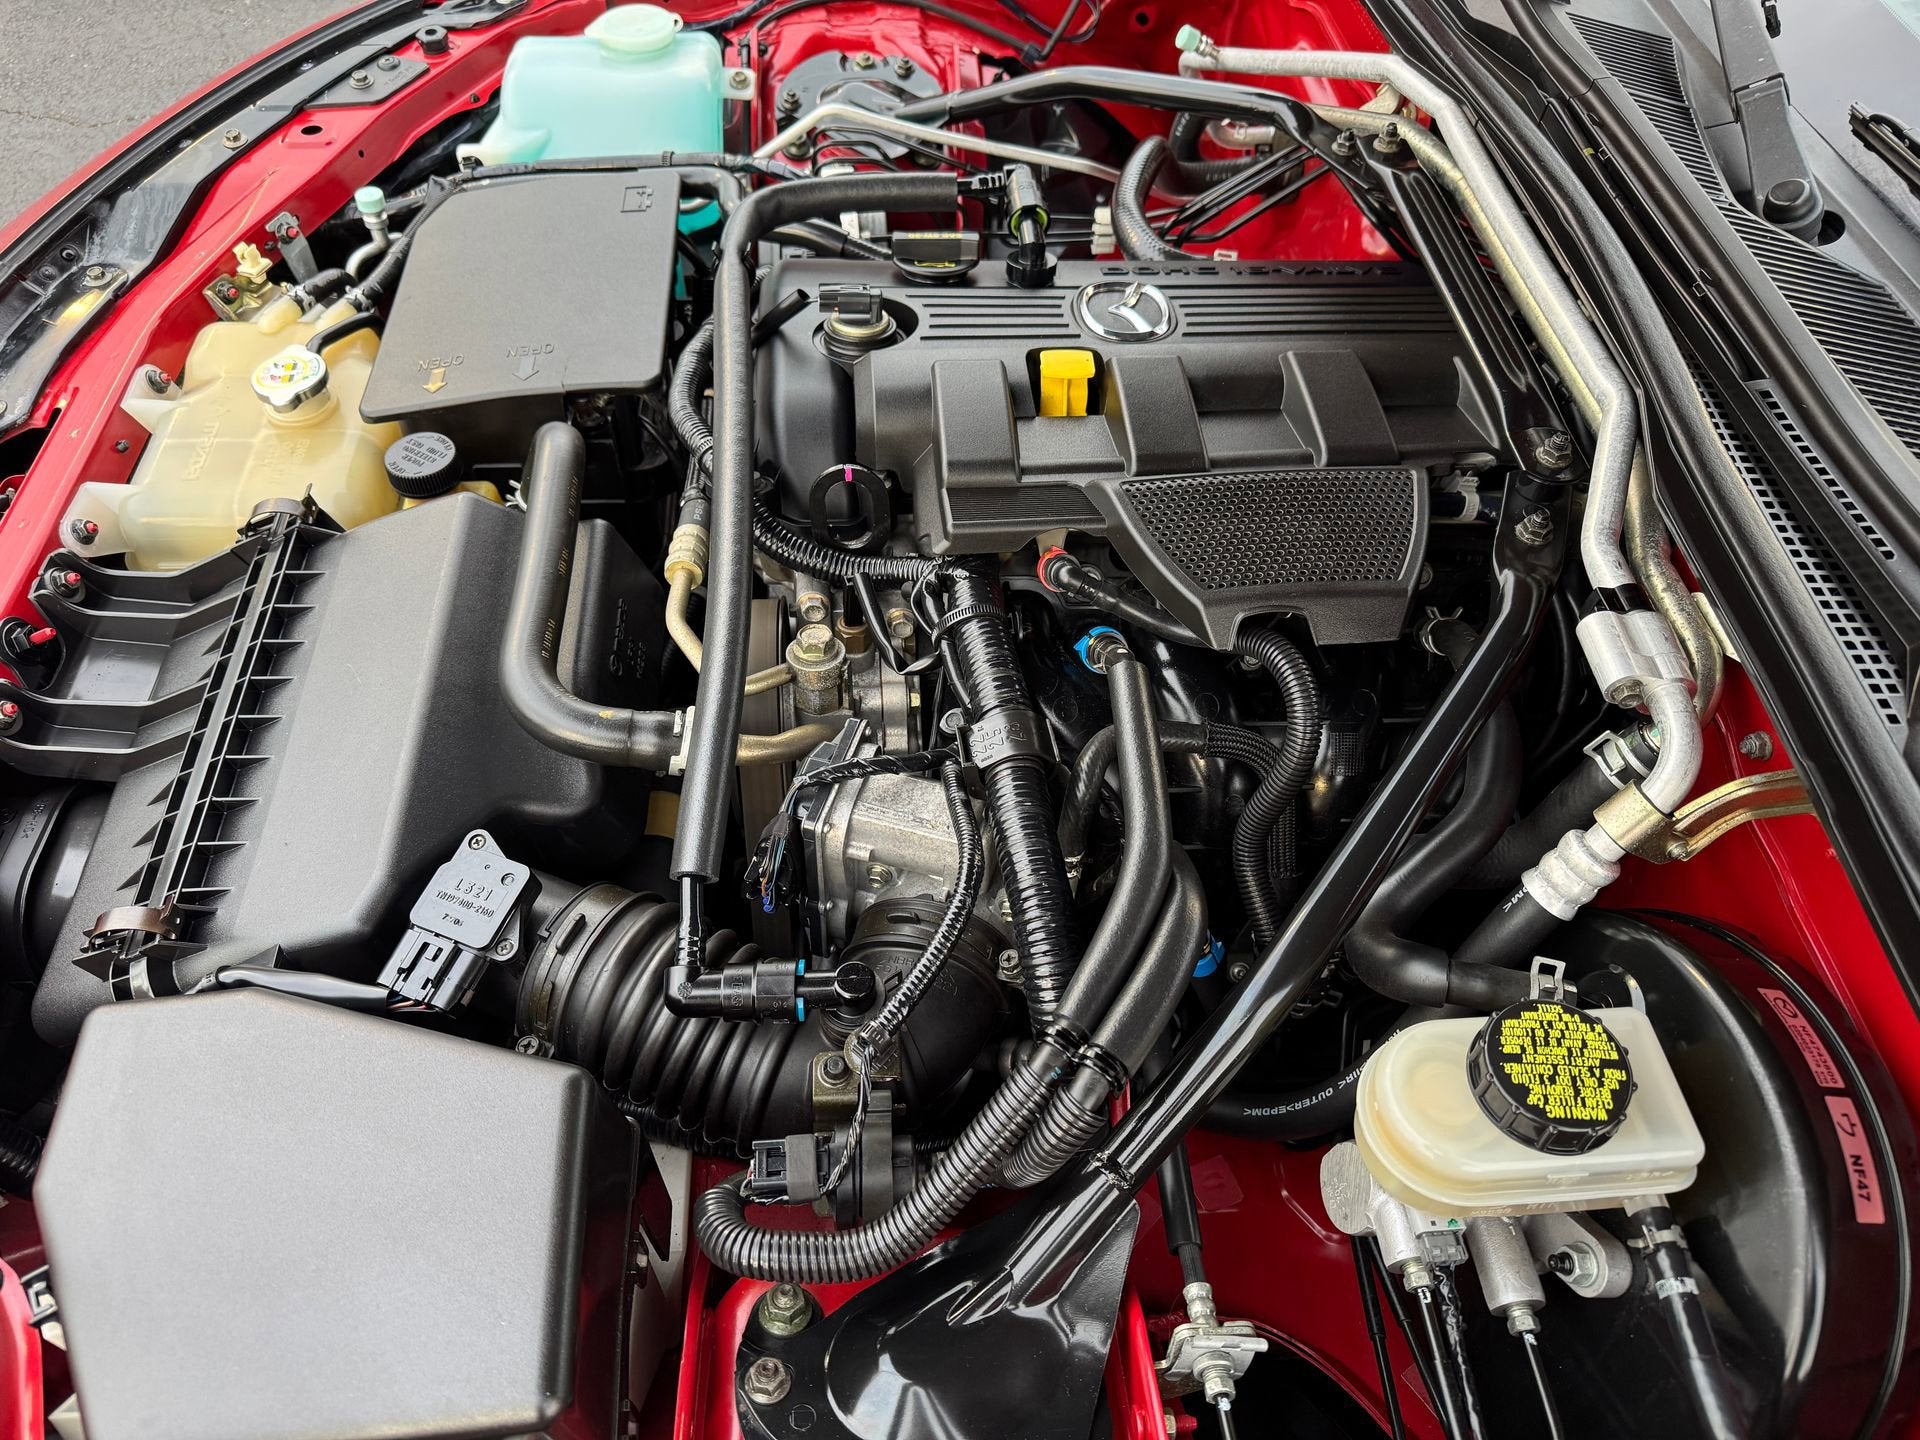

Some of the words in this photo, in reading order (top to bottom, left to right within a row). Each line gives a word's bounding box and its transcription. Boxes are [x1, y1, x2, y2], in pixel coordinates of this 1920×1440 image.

[1100, 266, 1219, 276] DOHC
[506, 343, 554, 358] OPEN
[418, 354, 464, 372] OPEN
[1520, 1011, 1559, 1019] CONTENANT
[1501, 1027, 1532, 1035] LIQUIDE
[1535, 1028, 1544, 1036] DU
[1593, 1024, 1603, 1032] DE
[1535, 1037, 1544, 1045] LE
[1548, 1038, 1557, 1046] DE
[1561, 1039, 1582, 1047] AVANT
[1586, 1040, 1616, 1049] LISSAGE
[1525, 1046, 1534, 1054] DE
[1571, 1048, 1580, 1056] LE
[1583, 1049, 1619, 1059] NETTOYER
[1522, 1053, 1600, 1066] AVERTISSEMENT
[1557, 1065, 1590, 1076] SEALED
[1593, 1068, 1600, 1076] A
[1604, 1069, 1626, 1079] FROM
[1511, 1073, 1540, 1083] FLUID
[1544, 1074, 1550, 1084] 3
[1556, 1075, 1571, 1085] DOT
[1576, 1076, 1598, 1086] ONLY
[1602, 1079, 1619, 1088] USE
[1580, 1087, 1611, 1097] BEFORE
[1527, 1094, 1544, 1104] CAP
[1548, 1095, 1582, 1106] FILLER
[1585, 1098, 1613, 1108] CLEAN
[1850, 1154, 1872, 1203] NF47
